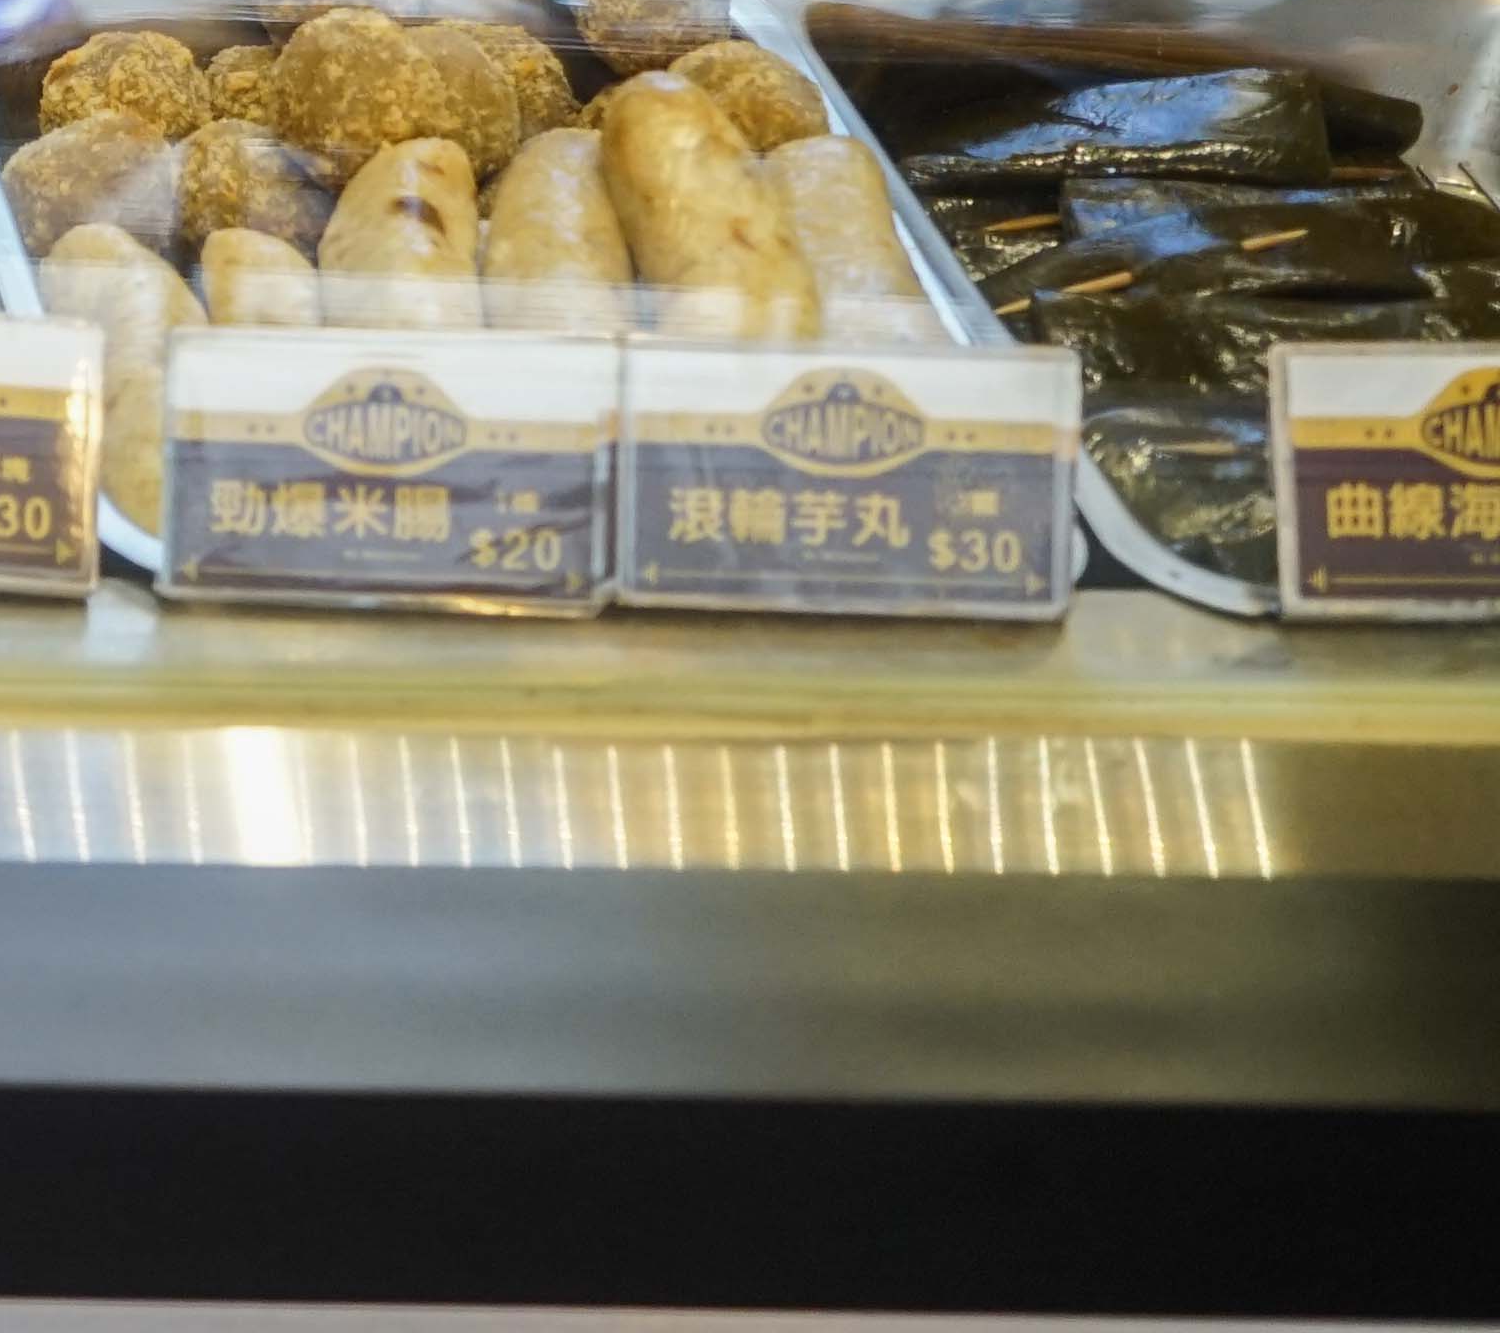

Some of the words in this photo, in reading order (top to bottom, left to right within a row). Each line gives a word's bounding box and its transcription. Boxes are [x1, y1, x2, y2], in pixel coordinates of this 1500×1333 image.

[307, 401, 467, 461] CHAMPION
[208, 478, 453, 544] 勁爆米腸
[467, 527, 564, 572] $20
[927, 529, 1023, 574] $30
